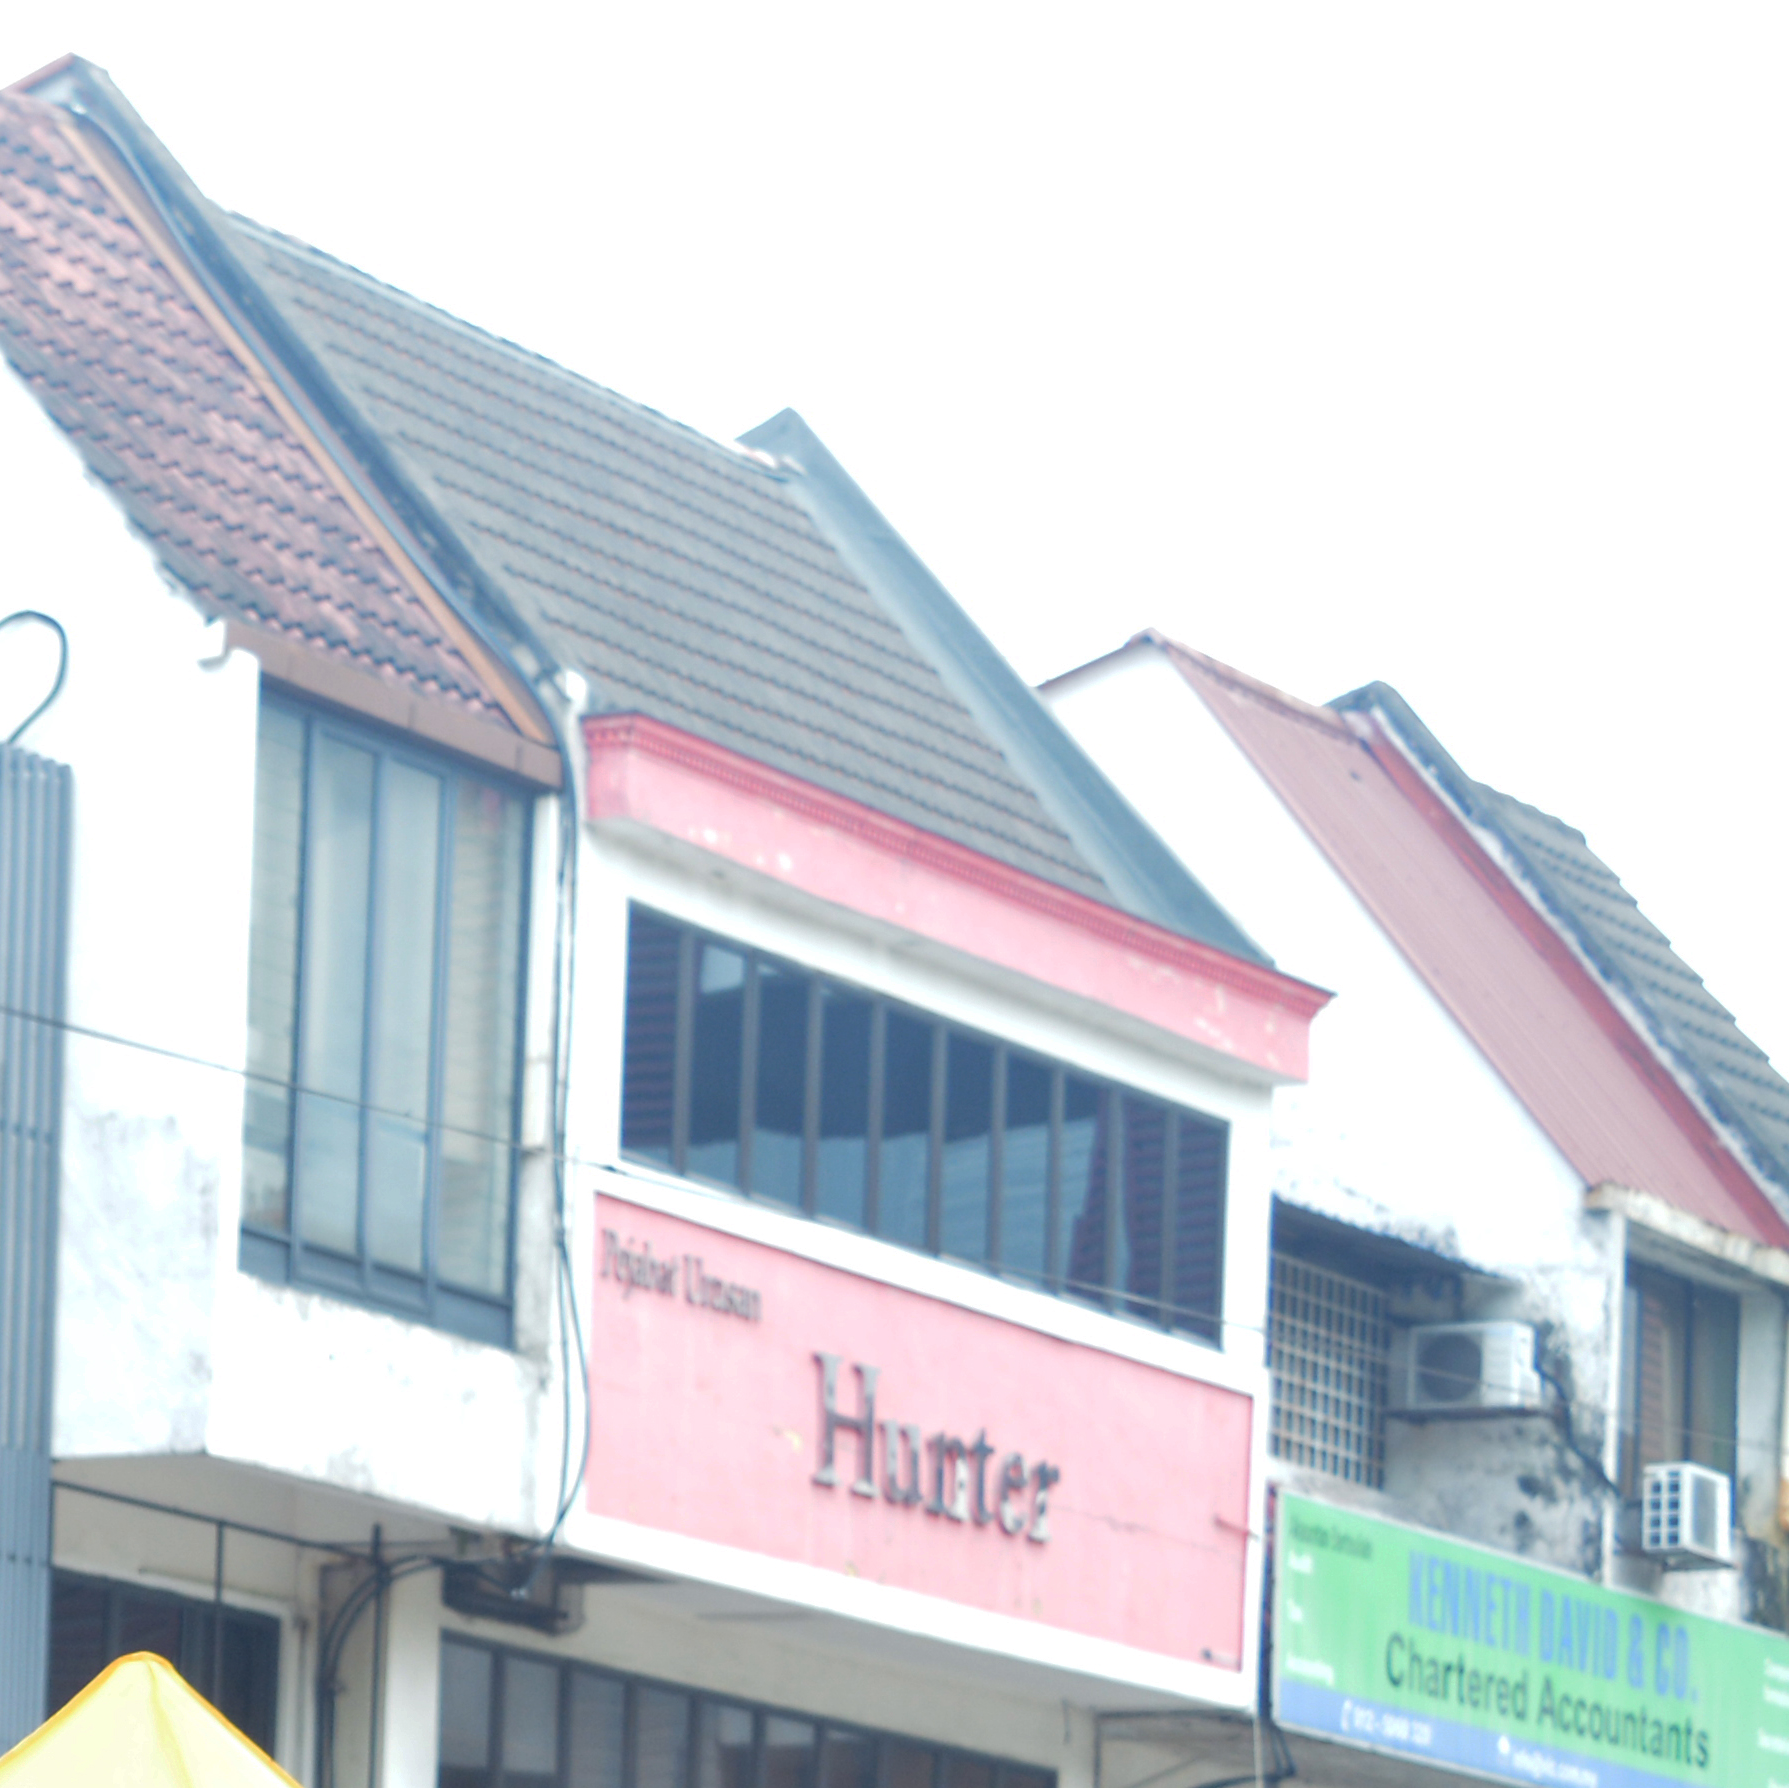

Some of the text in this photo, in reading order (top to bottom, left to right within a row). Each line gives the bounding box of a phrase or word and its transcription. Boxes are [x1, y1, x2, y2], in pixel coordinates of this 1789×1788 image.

[600, 1228, 679, 1302] Pejabat
[813, 1350, 1060, 1544] Hunter
[1408, 1550, 1698, 1702] KENNETH DAVID & CO.
[1385, 1633, 1711, 1769] Chartered Accountants
